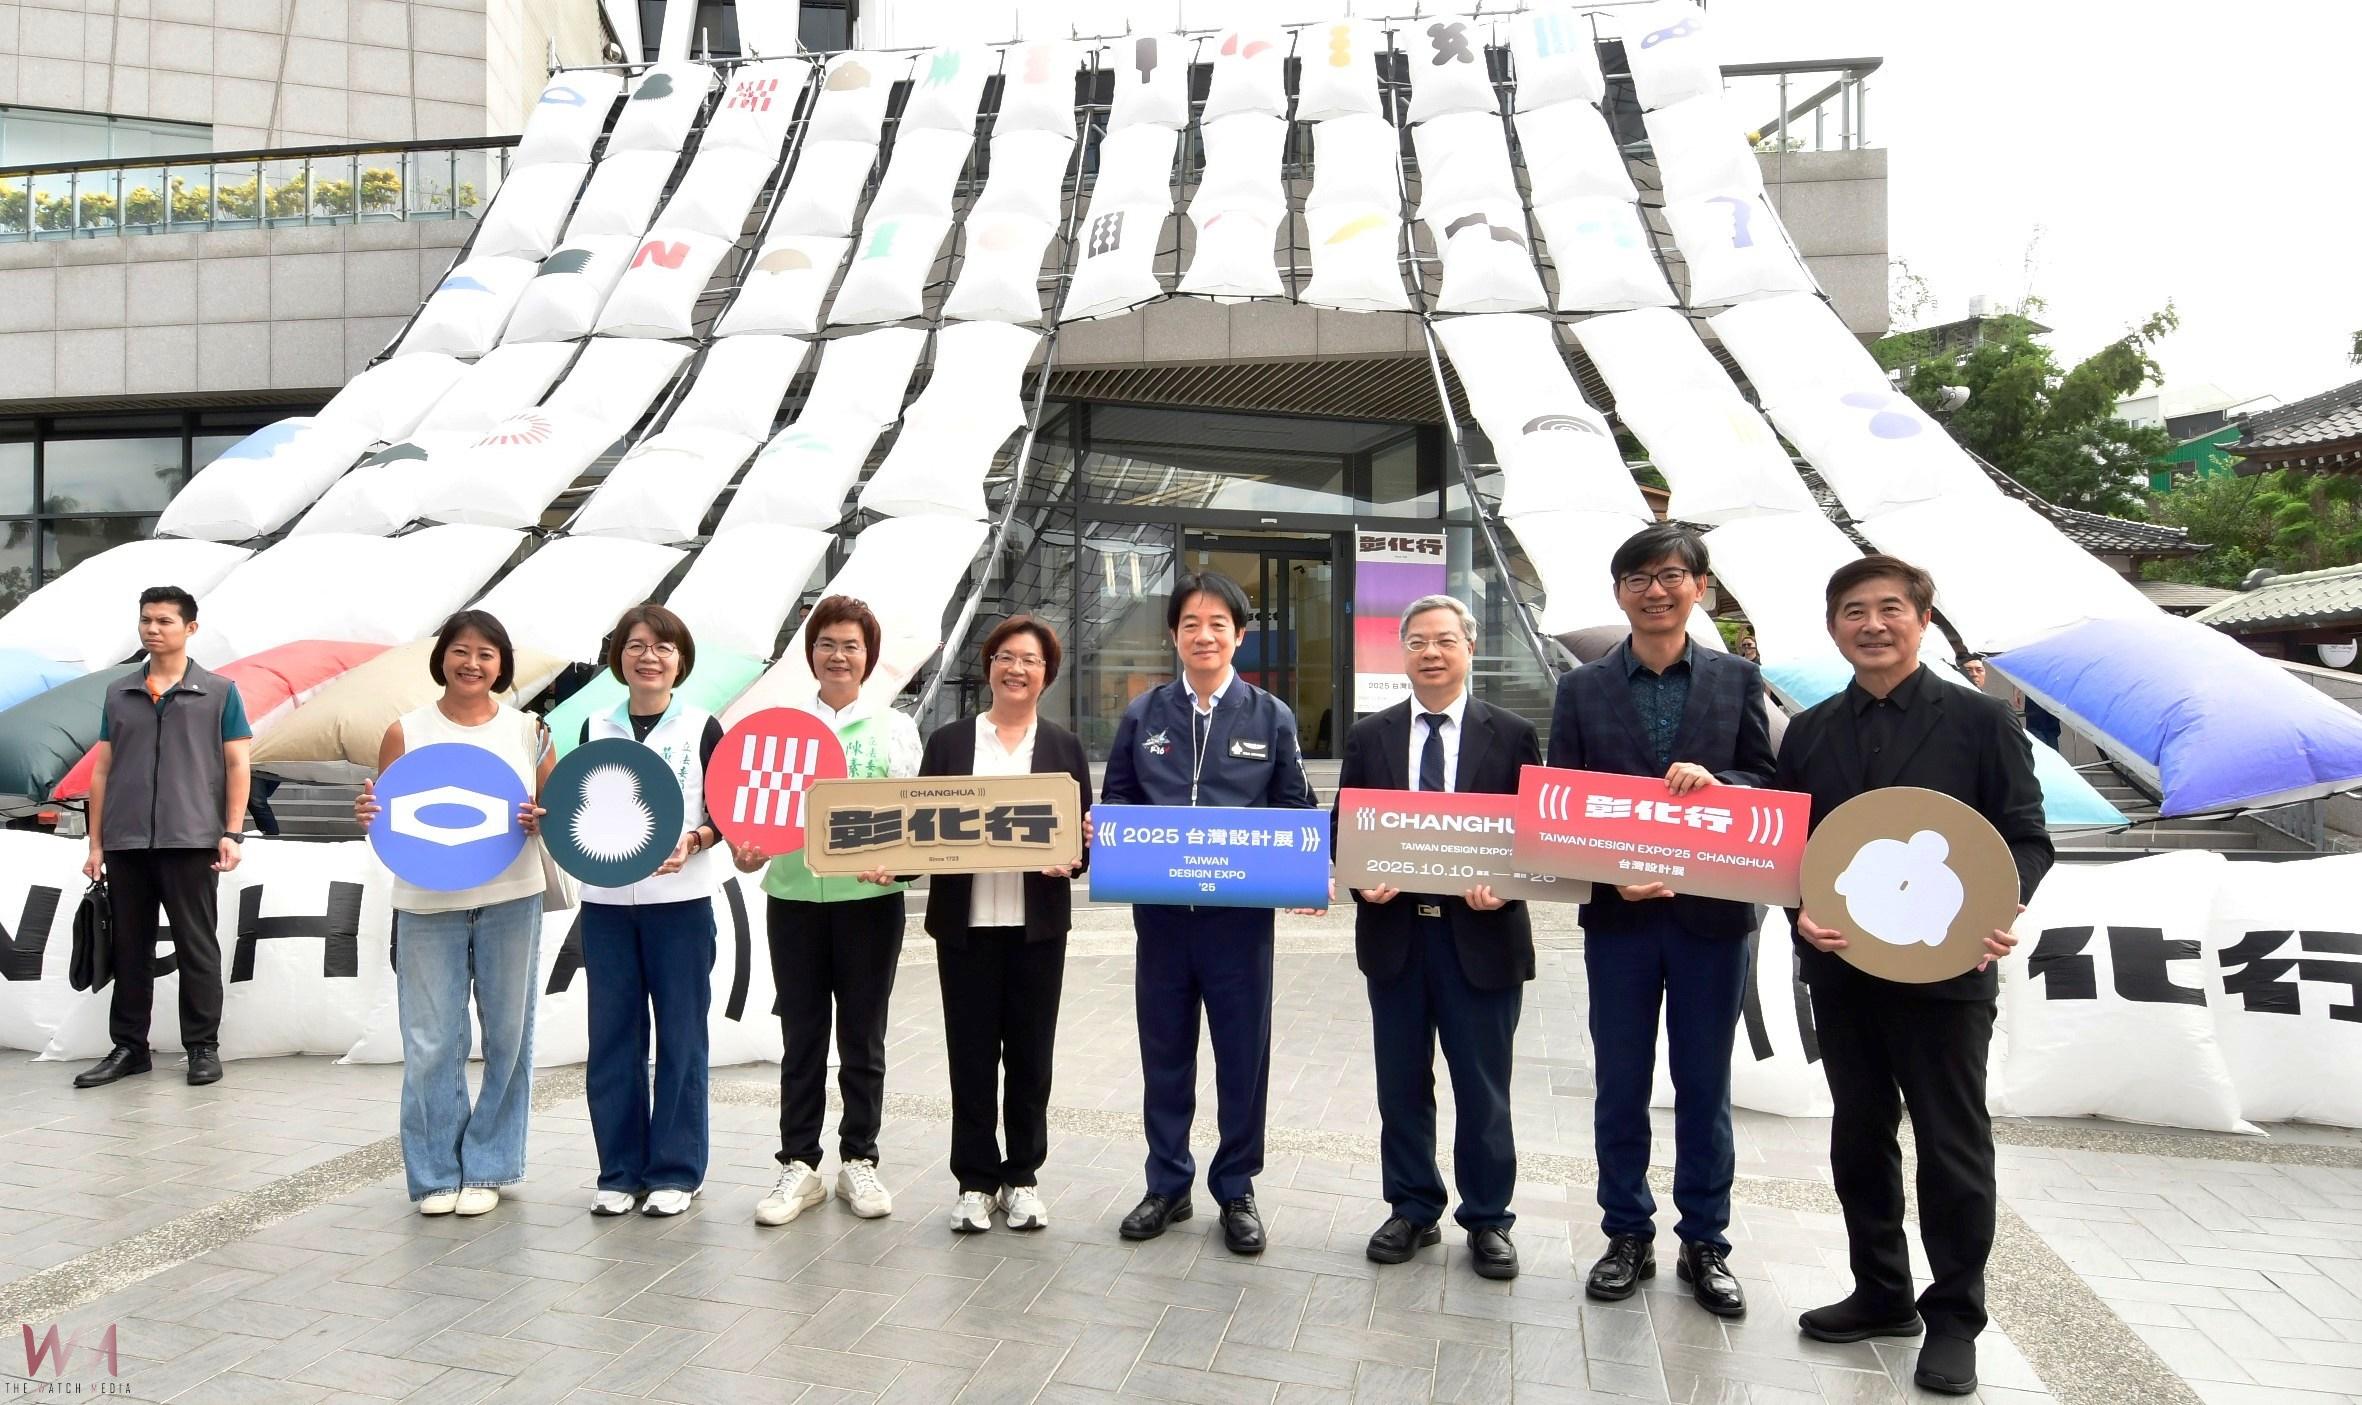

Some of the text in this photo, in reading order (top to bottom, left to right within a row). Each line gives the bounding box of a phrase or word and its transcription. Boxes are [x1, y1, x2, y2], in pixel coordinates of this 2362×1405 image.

[1359, 536, 1443, 556] 彰化行
[910, 788, 976, 798] CHANGHUA
[1585, 794, 1734, 834] 彰化行
[828, 803, 1059, 851] 彰化行
[1122, 827, 1294, 848] 2025 台灣設計展
[1400, 842, 1440, 853] TAIWAN
[1440, 844, 1478, 855] DESIGN
[1539, 831, 1776, 870] TAIWAN DESIGN EXPO'25 CHANGHUA
[1183, 855, 1229, 867] TAIWAN
[1366, 859, 1475, 878] 2025.10.10
[1618, 858, 1686, 877] 台灣設計展
[1169, 868, 1247, 880] DESIGN EXPO
